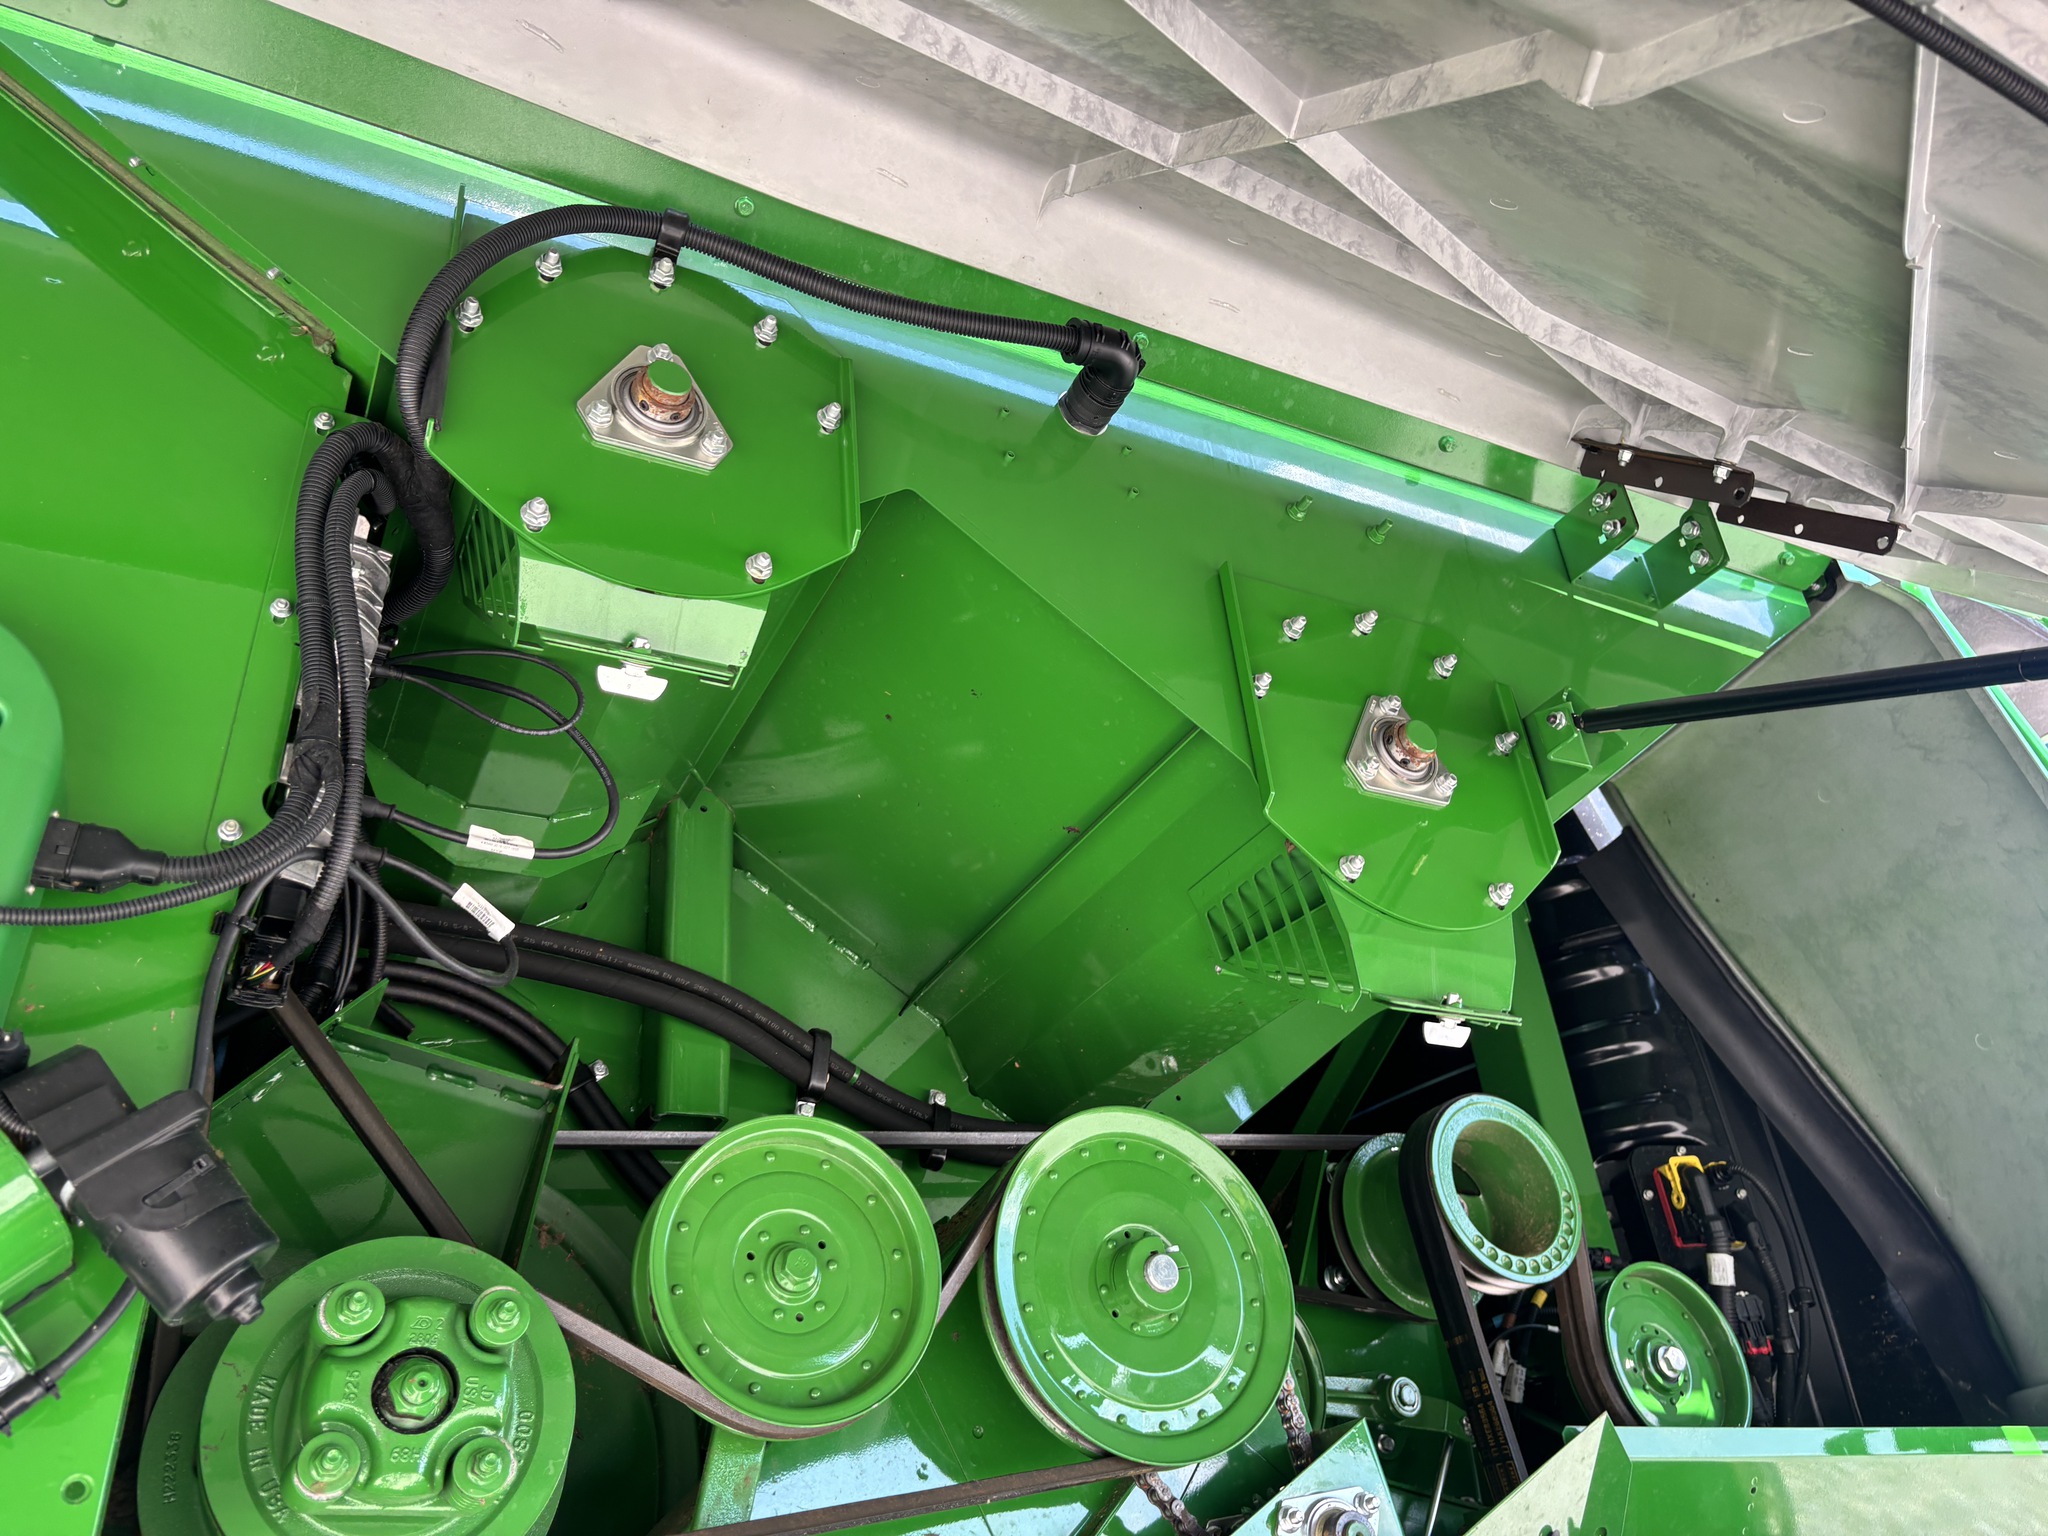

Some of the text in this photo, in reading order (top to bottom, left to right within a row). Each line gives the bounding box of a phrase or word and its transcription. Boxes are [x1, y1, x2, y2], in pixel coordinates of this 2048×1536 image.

[246, 1375, 290, 1524] MADE IN USA
